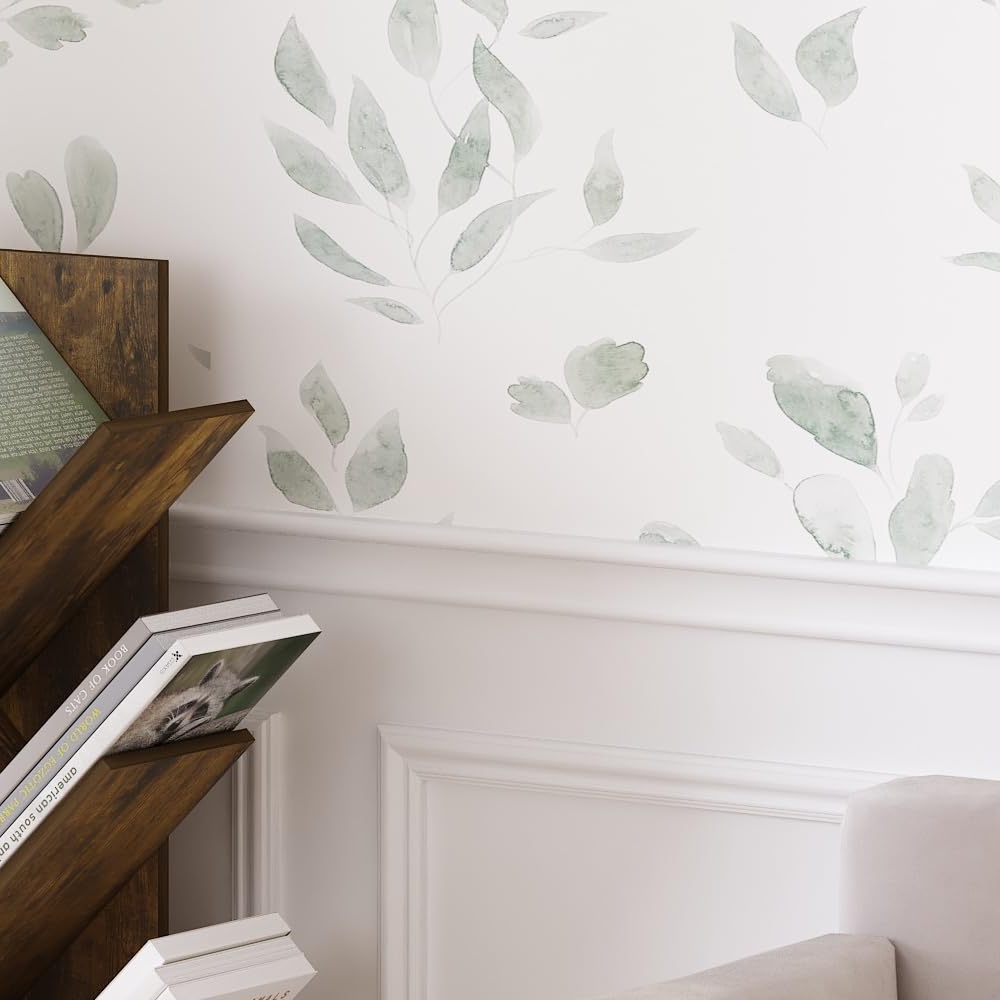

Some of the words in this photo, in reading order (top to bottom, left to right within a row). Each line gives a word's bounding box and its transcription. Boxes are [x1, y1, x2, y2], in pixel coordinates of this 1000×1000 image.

[102, 644, 128, 674] BOOK
[90, 674, 102, 690] OF
[64, 690, 88, 715] CATS
[70, 708, 101, 742] WORLD
[58, 742, 70, 757] OF
[36, 766, 78, 814] american
[10, 813, 36, 842] south
